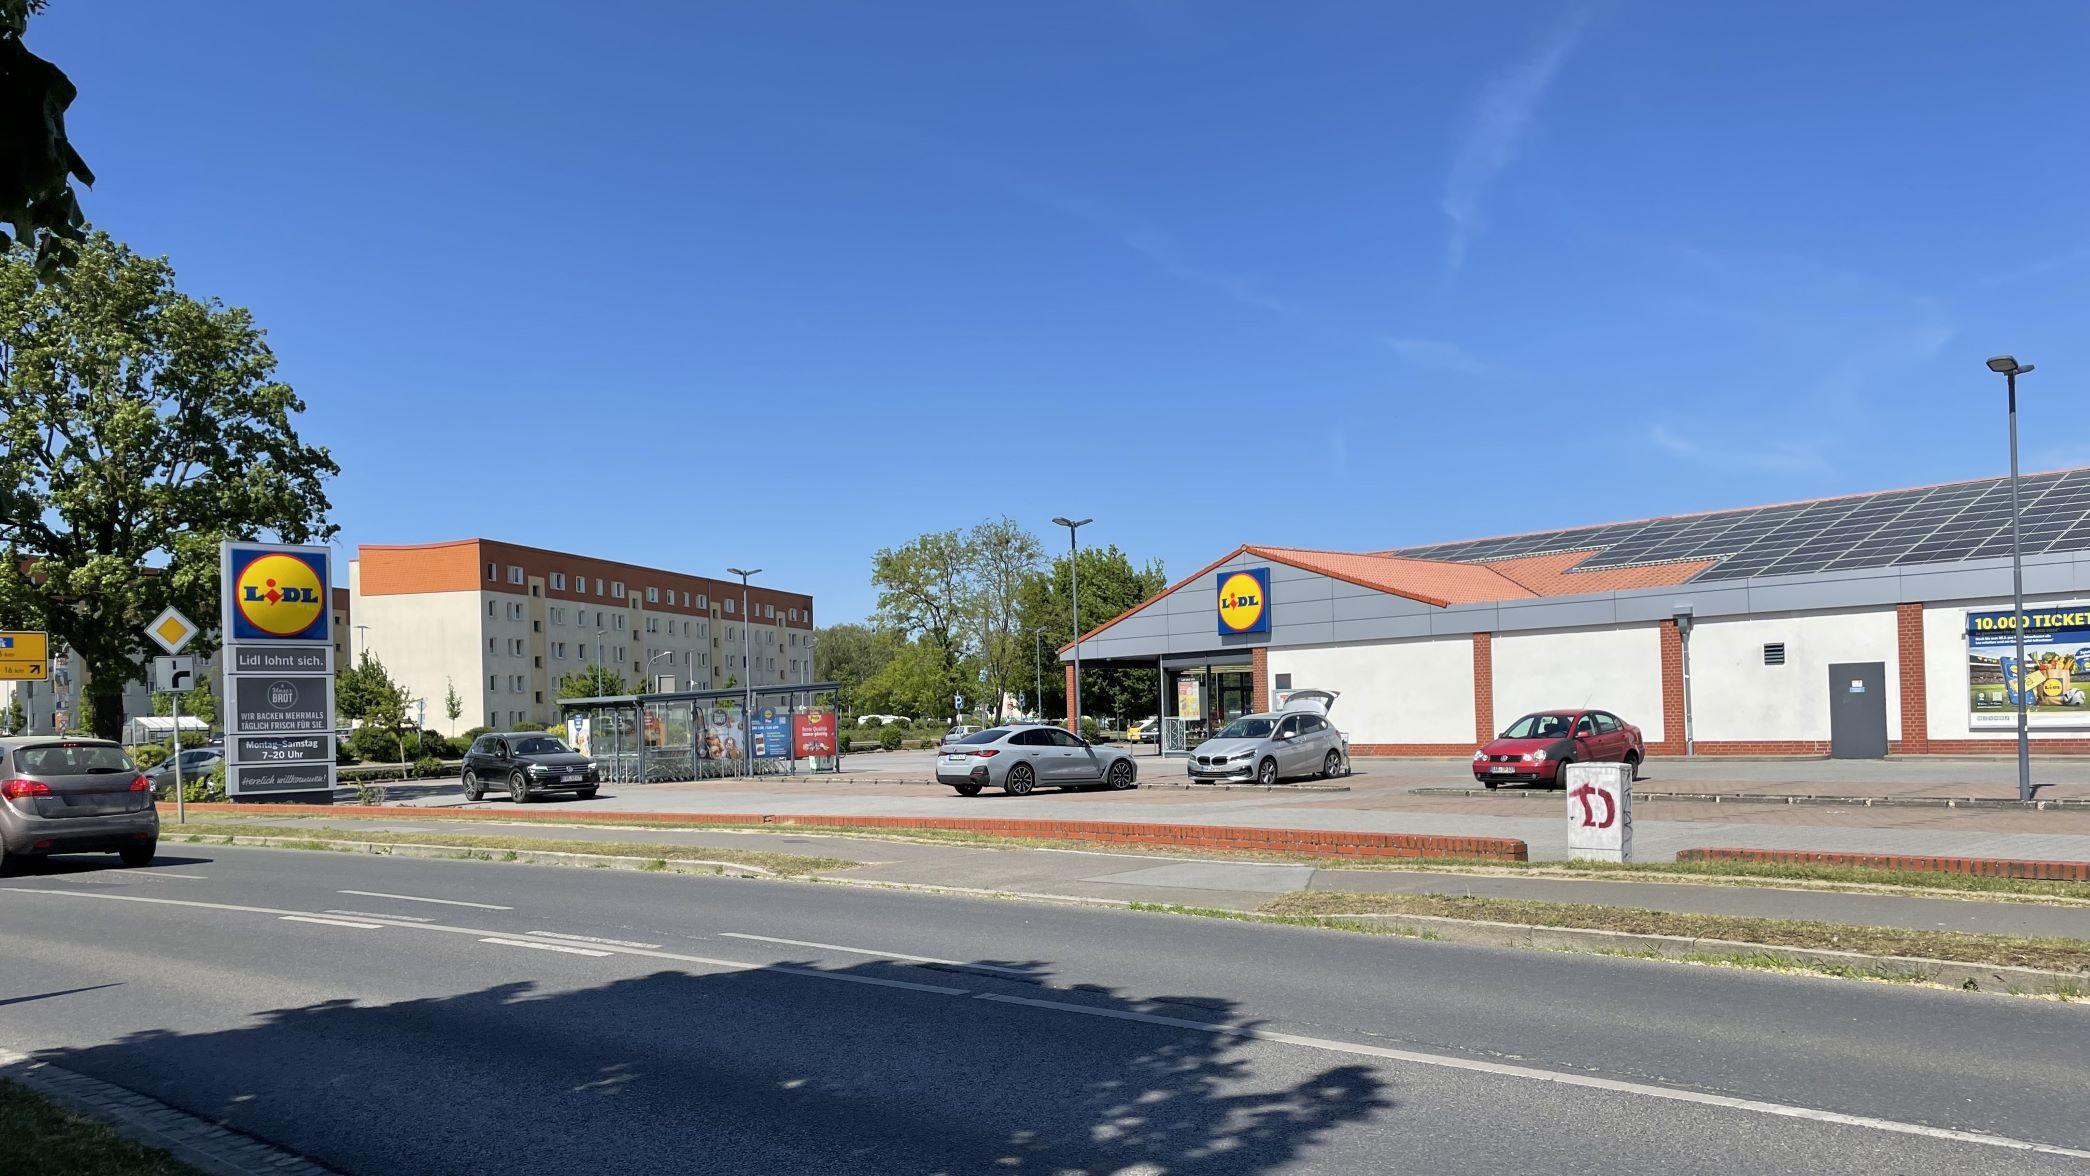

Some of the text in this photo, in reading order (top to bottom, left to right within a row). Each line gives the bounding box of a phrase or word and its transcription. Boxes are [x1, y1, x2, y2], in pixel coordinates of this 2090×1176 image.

[1975, 616, 2029, 629] 10.000
[240, 655, 324, 666] Lidl lohnt sich.
[272, 693, 293, 703] BROT
[241, 711, 324, 721] WIR BACKEN MEHRMALS
[242, 720, 325, 730] TÄGLICH FRISCH FÜR SIE.
[287, 750, 304, 759] Uhr
[242, 773, 327, 786] Herzlich willkommen!
